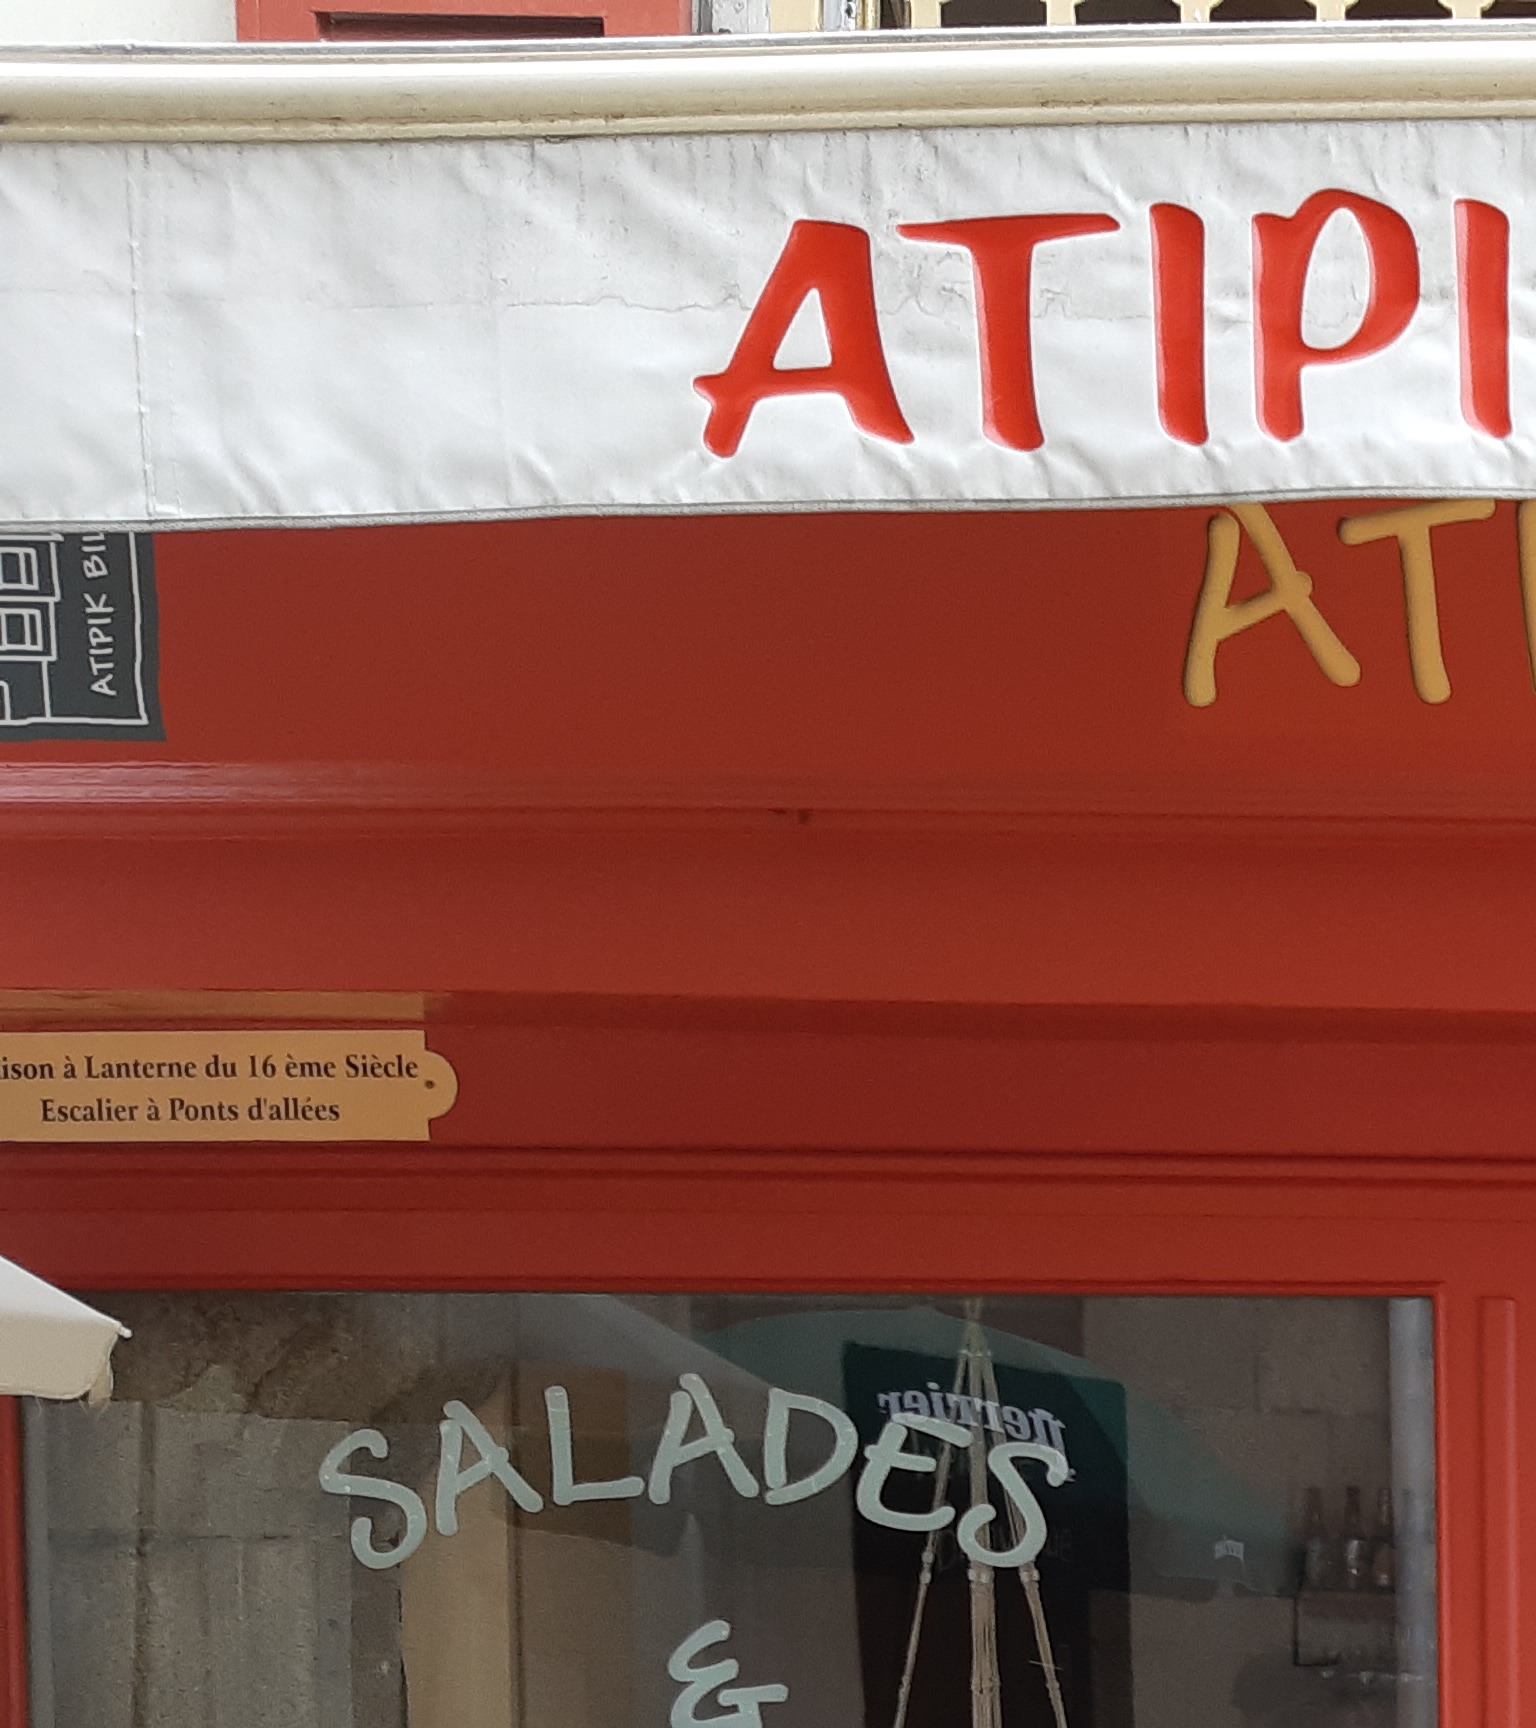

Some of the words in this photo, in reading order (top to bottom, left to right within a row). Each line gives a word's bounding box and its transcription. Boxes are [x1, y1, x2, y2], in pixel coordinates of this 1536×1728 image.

[81, 532, 109, 580] BIL
[82, 592, 118, 697] ATIPIK
[0, 1055, 55, 1080] ison
[63, 1055, 78, 1080] à
[84, 1055, 197, 1080] Lanterne
[205, 1054, 237, 1079] du
[249, 1054, 277, 1079] 16
[285, 1055, 336, 1079] ème
[345, 1053, 419, 1079] Siècle
[41, 1098, 139, 1123] Escalier
[146, 1098, 161, 1122] à
[168, 1098, 239, 1122] Ponts
[247, 1096, 340, 1122] d'allées
[318, 1372, 1071, 1569] SALADES
